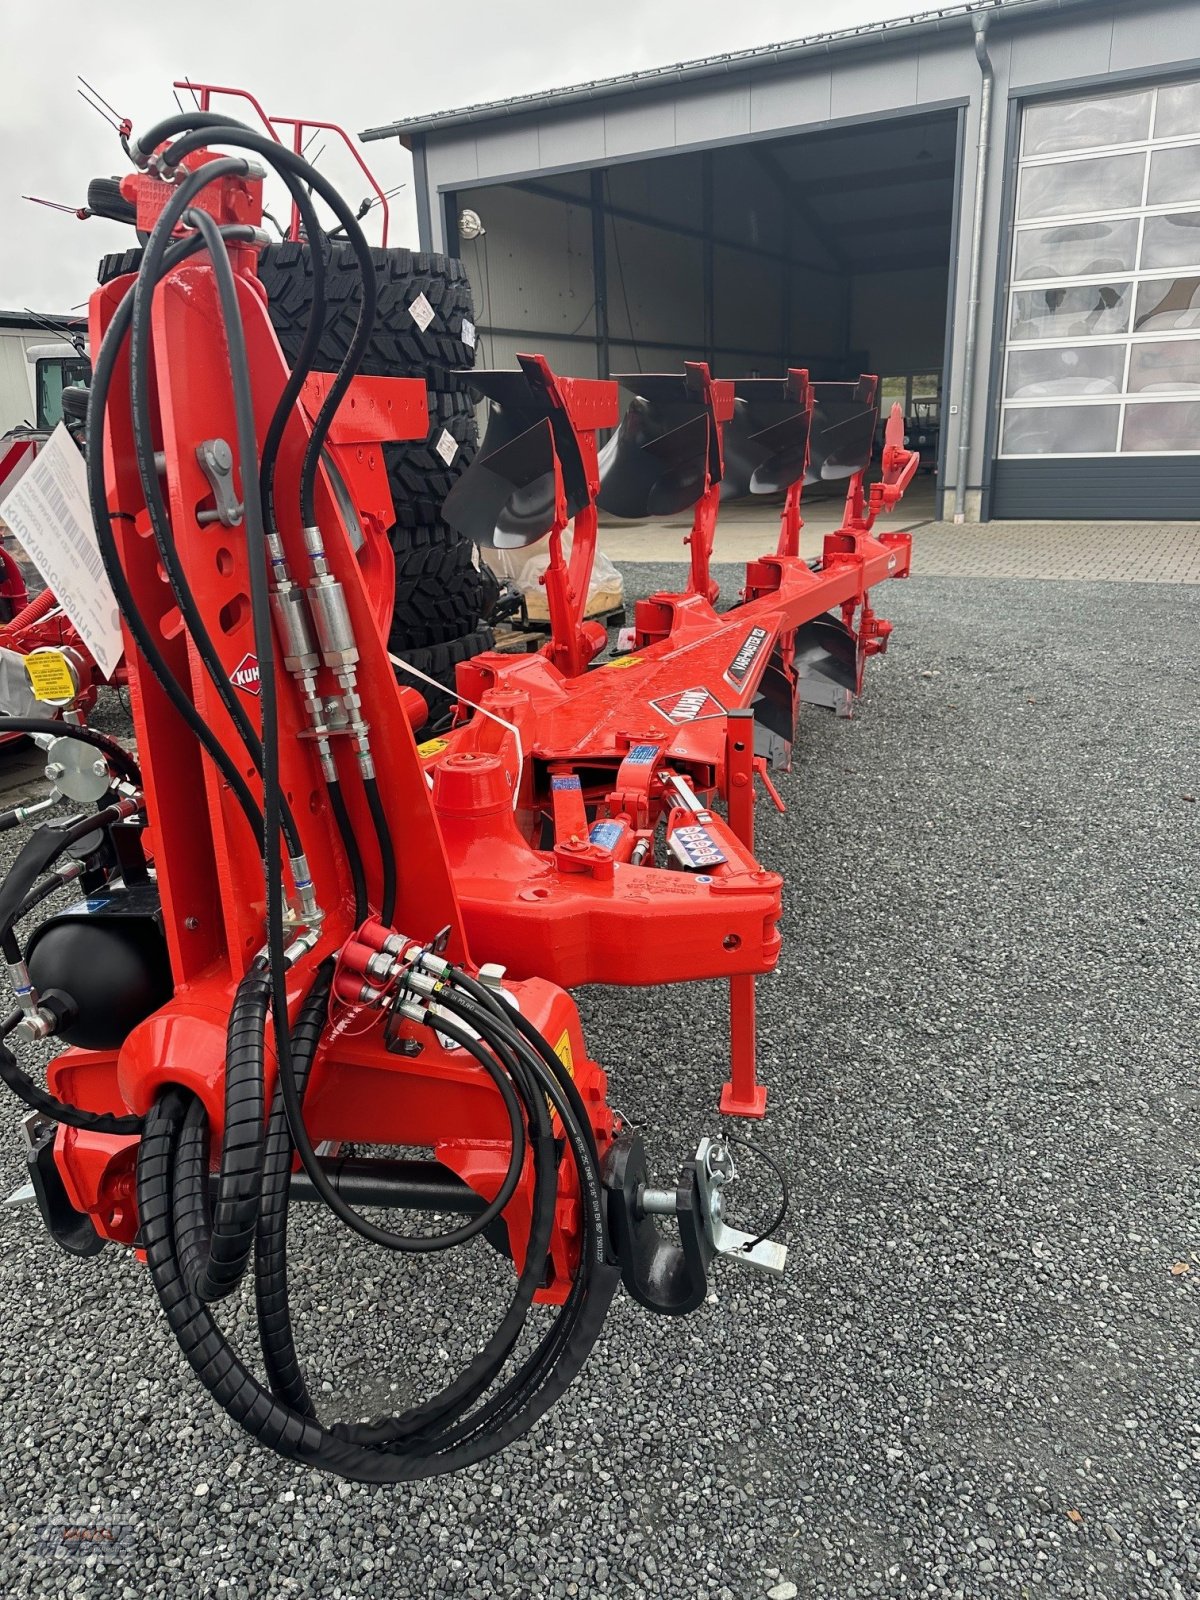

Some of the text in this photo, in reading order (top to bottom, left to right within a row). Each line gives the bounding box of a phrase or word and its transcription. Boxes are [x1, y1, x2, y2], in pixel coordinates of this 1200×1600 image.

[731, 635, 763, 671] VARI-MASTER
[236, 666, 260, 686] KUH
[668, 690, 710, 720] KUHN
[692, 840, 707, 848] 16
[697, 847, 712, 855] 18
[701, 855, 719, 863] 20
